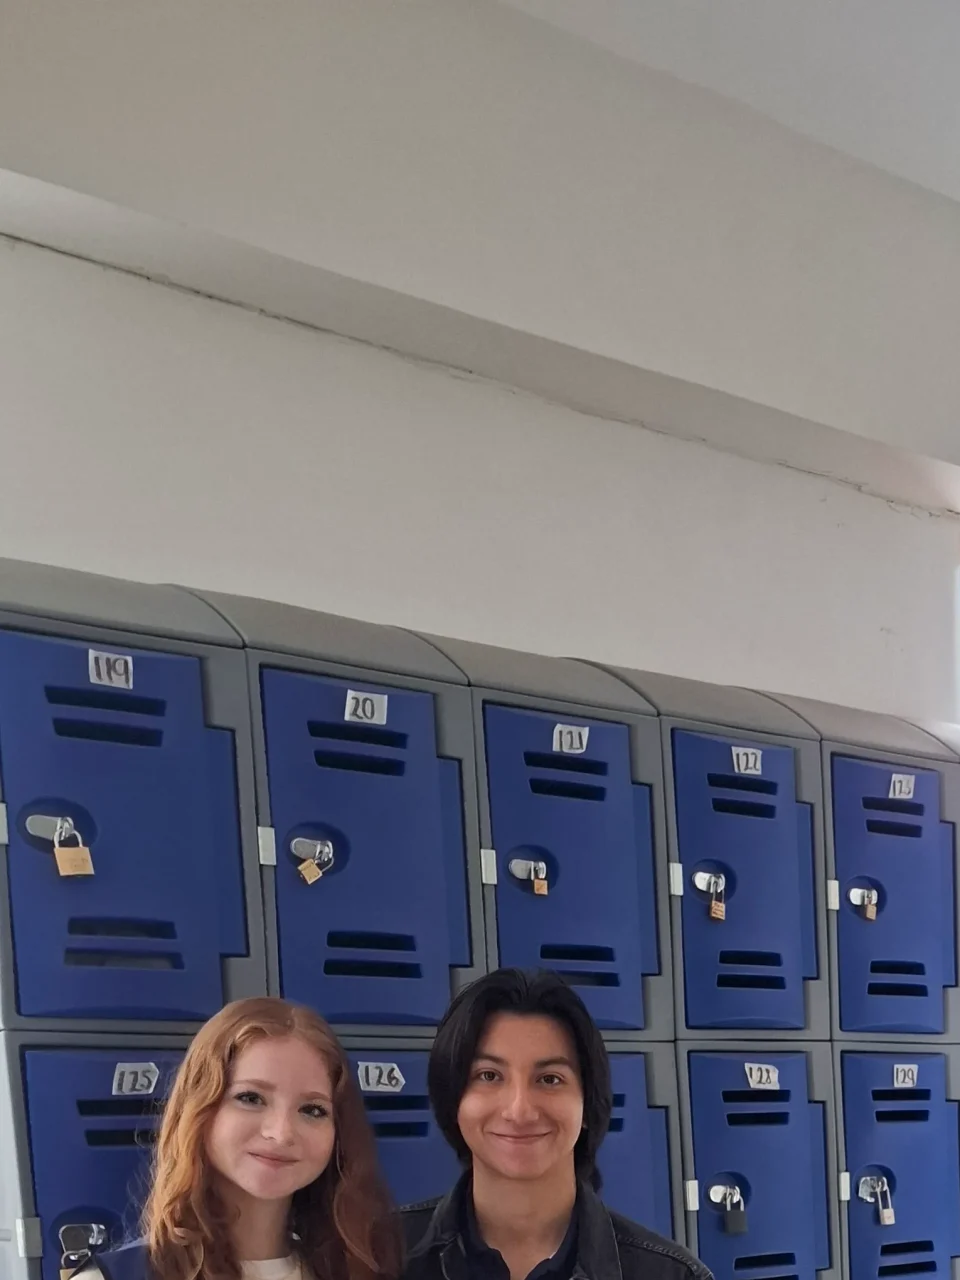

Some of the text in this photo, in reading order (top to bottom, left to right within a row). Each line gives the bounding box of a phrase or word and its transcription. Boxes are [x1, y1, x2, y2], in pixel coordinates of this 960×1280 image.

[93, 655, 131, 690] 119
[559, 730, 584, 754] 121
[735, 752, 760, 774] 122
[116, 1069, 152, 1094] 125
[364, 1065, 400, 1088] 126
[748, 1066, 772, 1085] 128
[895, 1068, 915, 1086] 129
